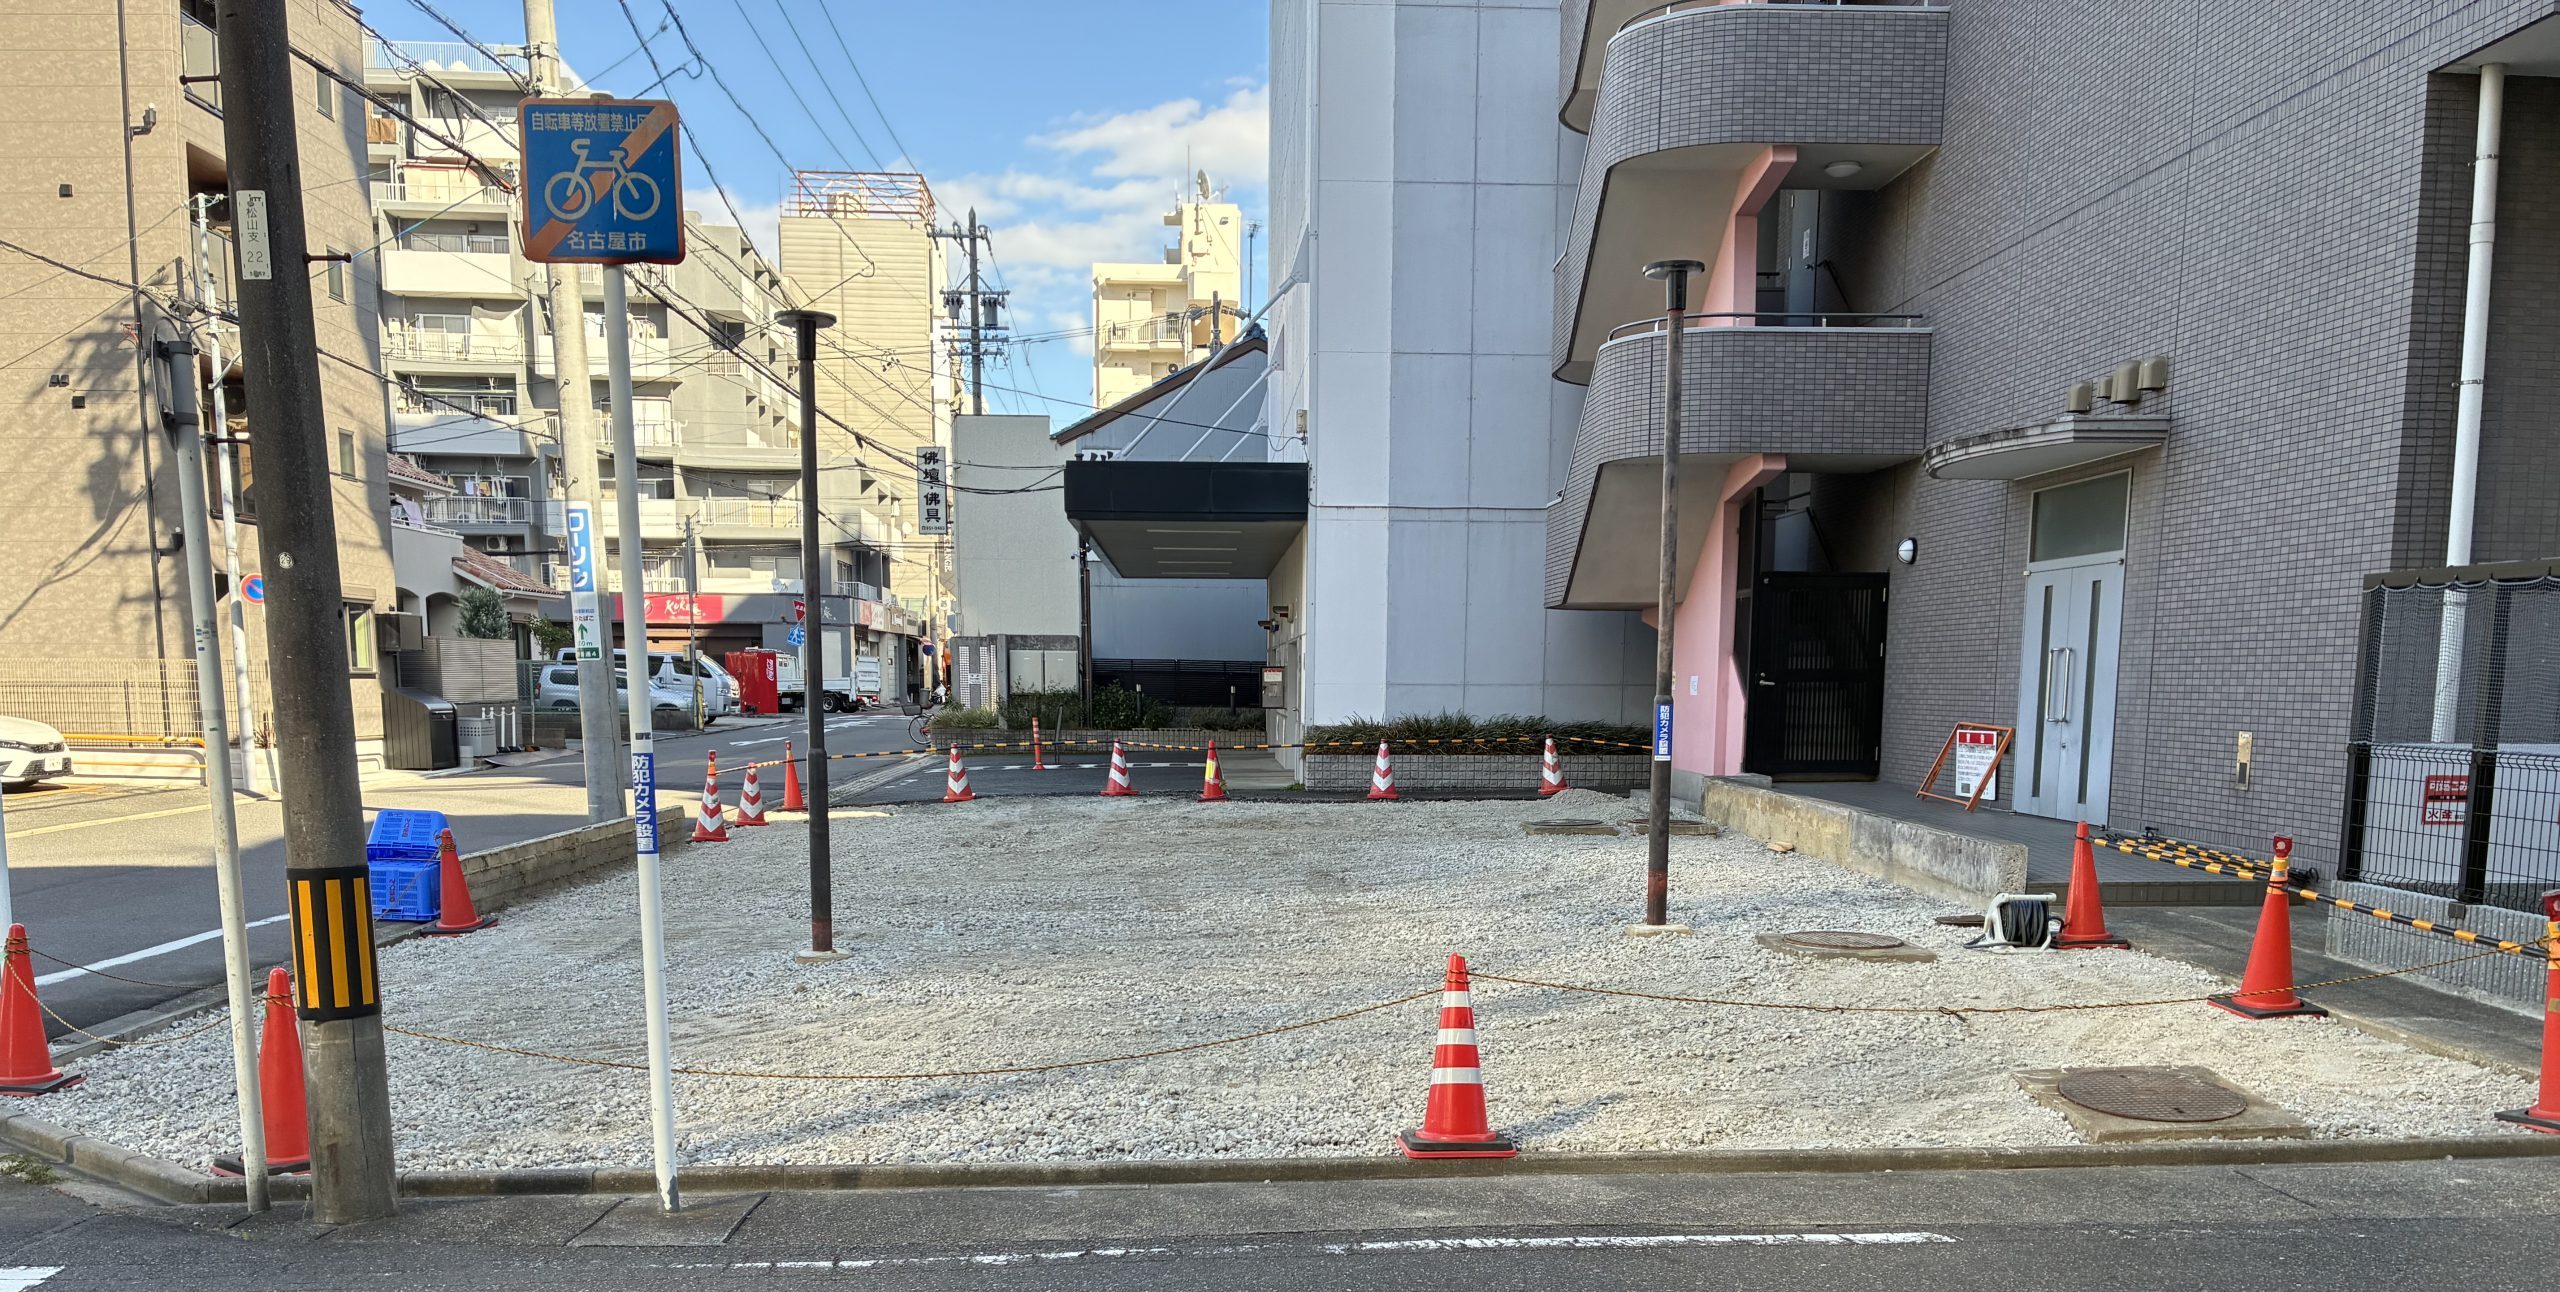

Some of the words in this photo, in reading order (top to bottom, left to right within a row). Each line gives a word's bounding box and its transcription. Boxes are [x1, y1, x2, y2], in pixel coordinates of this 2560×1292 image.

[246, 207, 260, 242] 松山支
[567, 231, 647, 250] 名古屋市
[247, 250, 263, 263] 22
[632, 755, 654, 850] 防犯カメラ設置
